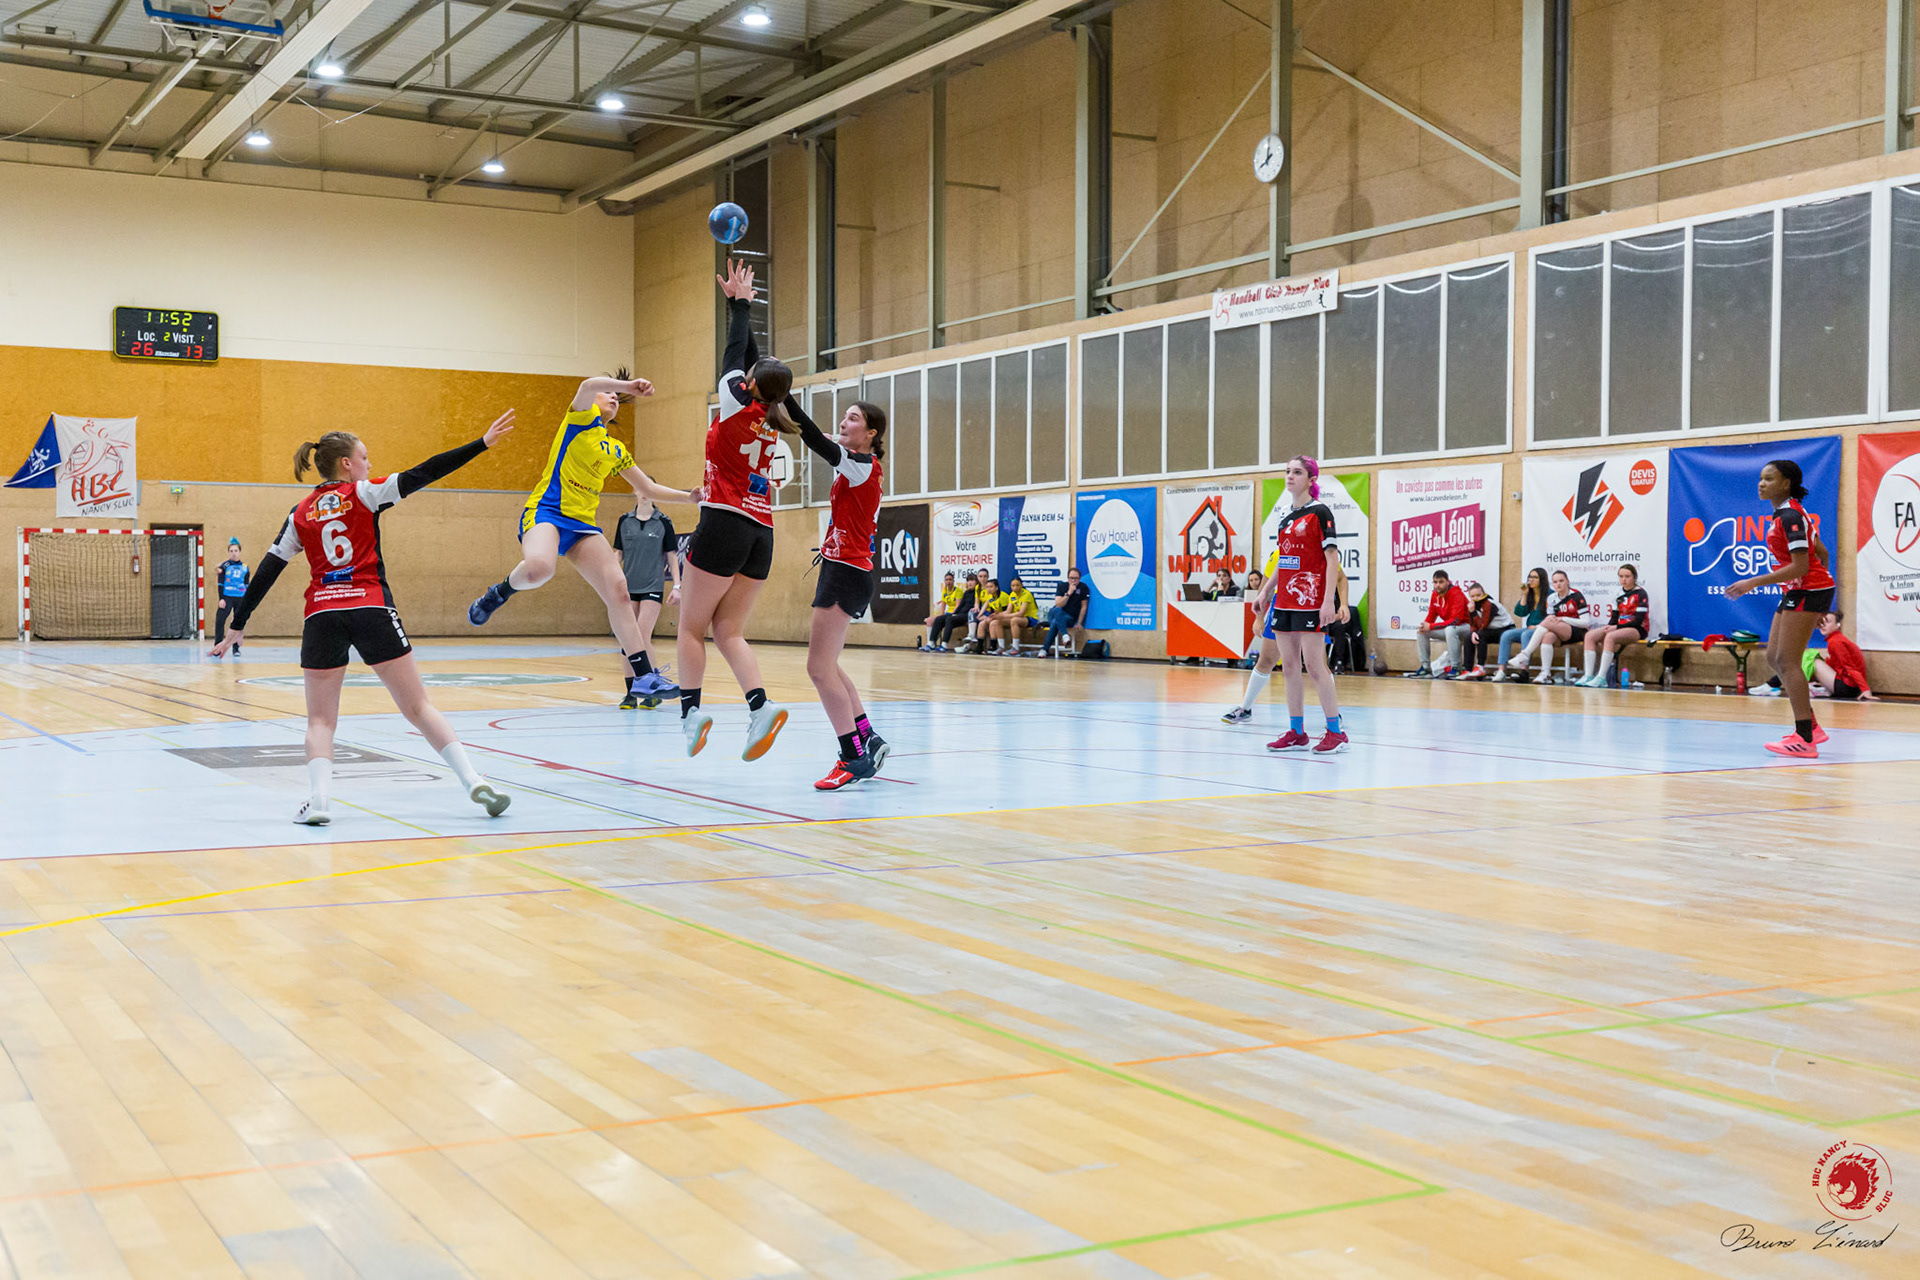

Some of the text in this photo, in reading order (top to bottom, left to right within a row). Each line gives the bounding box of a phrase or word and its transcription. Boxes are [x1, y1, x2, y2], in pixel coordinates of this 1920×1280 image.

[1229, 289, 1262, 306] Handball
[1265, 286, 1283, 299] Club
[1284, 284, 1309, 298] Nancy
[147, 311, 192, 326] 11:52
[131, 342, 154, 356] 26
[187, 345, 204, 359] 13
[1631, 470, 1655, 479] DEVIS
[1404, 480, 1423, 493] caviste
[1424, 481, 1434, 493] pas
[1434, 480, 1455, 491] comme
[1455, 477, 1464, 490] les
[1464, 476, 1483, 490] autres
[1631, 479, 1655, 487] GRATUIT
[82, 497, 134, 515] NANCY SLUC
[1284, 519, 1293, 534] 2
[1393, 510, 1475, 557] la Cave de Léon
[321, 519, 354, 567] 6
[1090, 529, 1139, 545] Guy Hoquet
[955, 540, 977, 551] Votre
[940, 554, 994, 565] PARTENAIRE
[1546, 550, 1641, 562] HelloHomeLorraine
[1398, 579, 1411, 593] 03
[1414, 579, 1428, 593] 83
